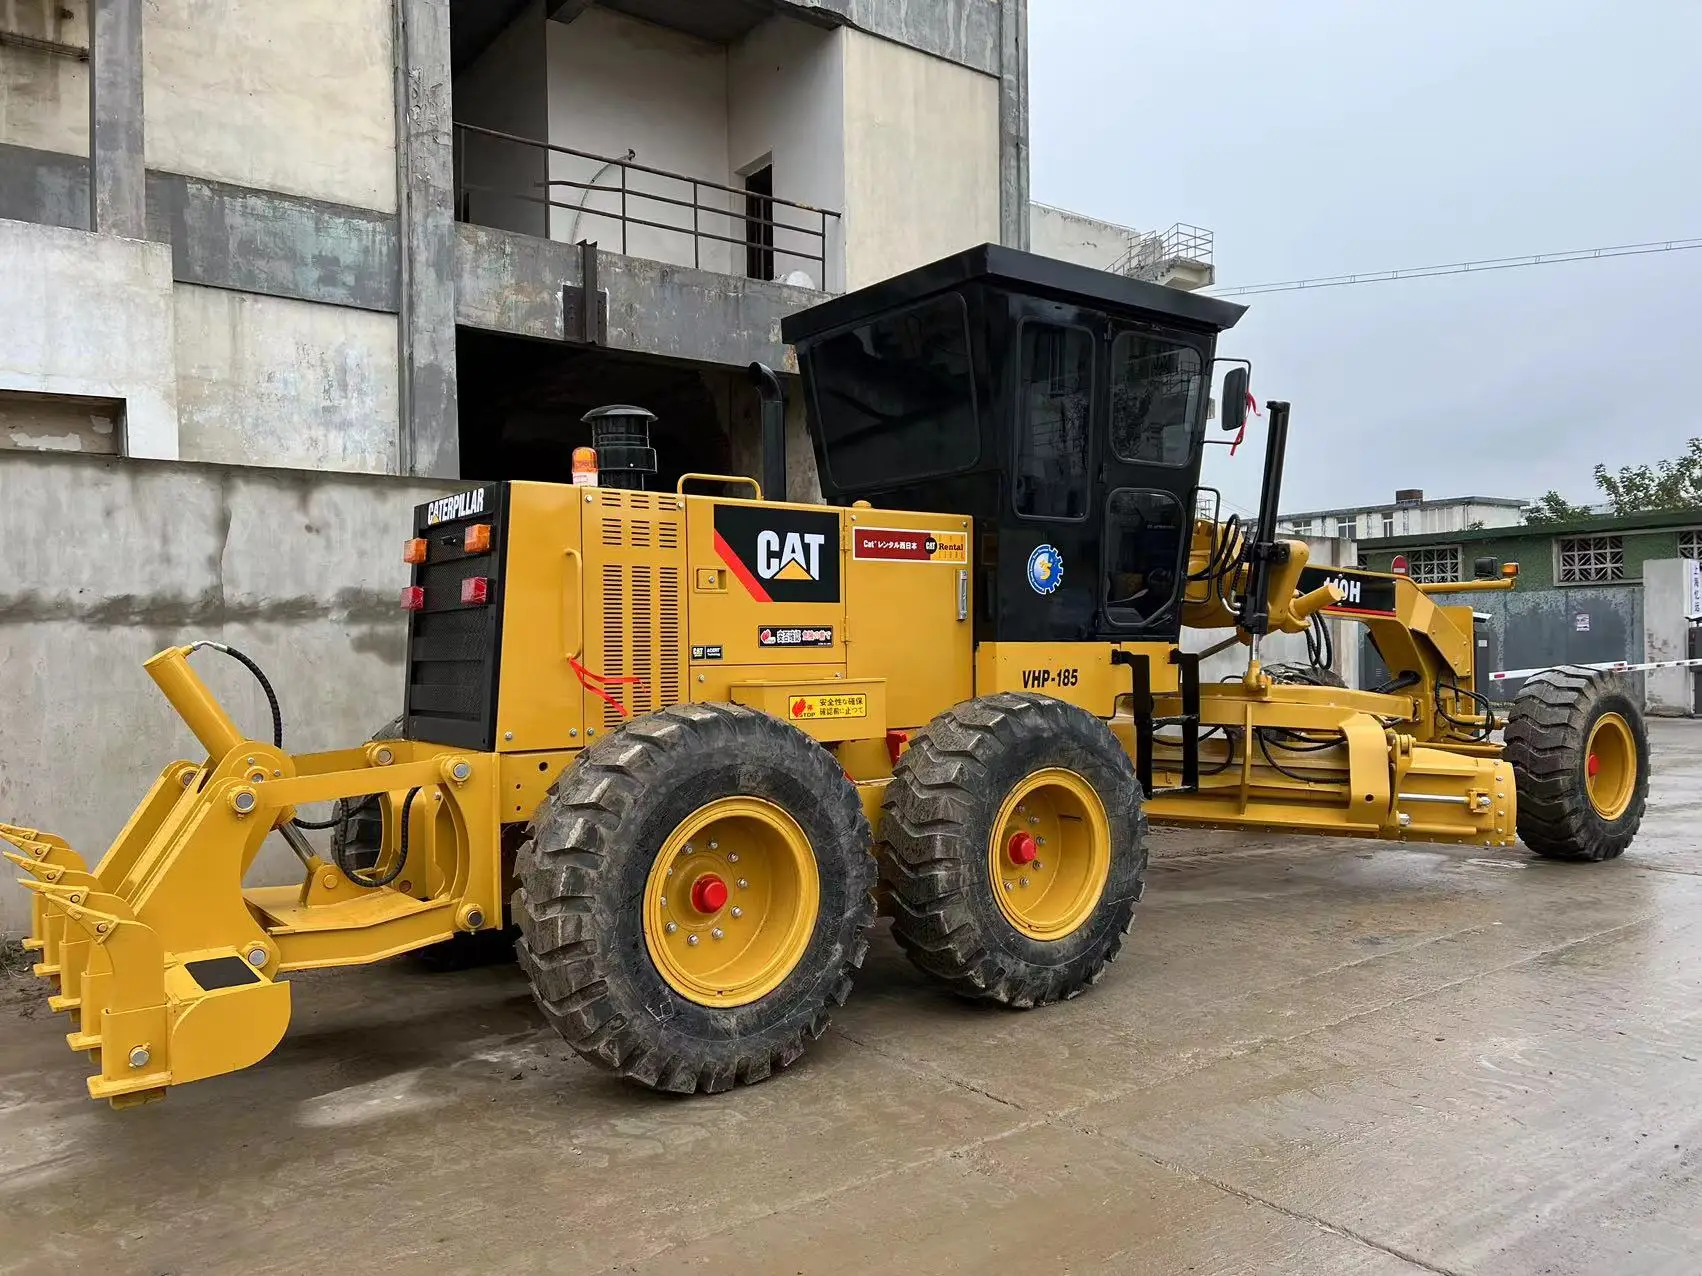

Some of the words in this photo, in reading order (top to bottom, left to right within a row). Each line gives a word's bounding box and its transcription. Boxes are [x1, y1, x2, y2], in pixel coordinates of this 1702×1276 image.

[428, 488, 484, 525] CATERPILLAR
[757, 530, 825, 580] CAT
[925, 542, 936, 550] CAT
[939, 543, 964, 551] Rental
[1022, 669, 1078, 688] VHP-185
